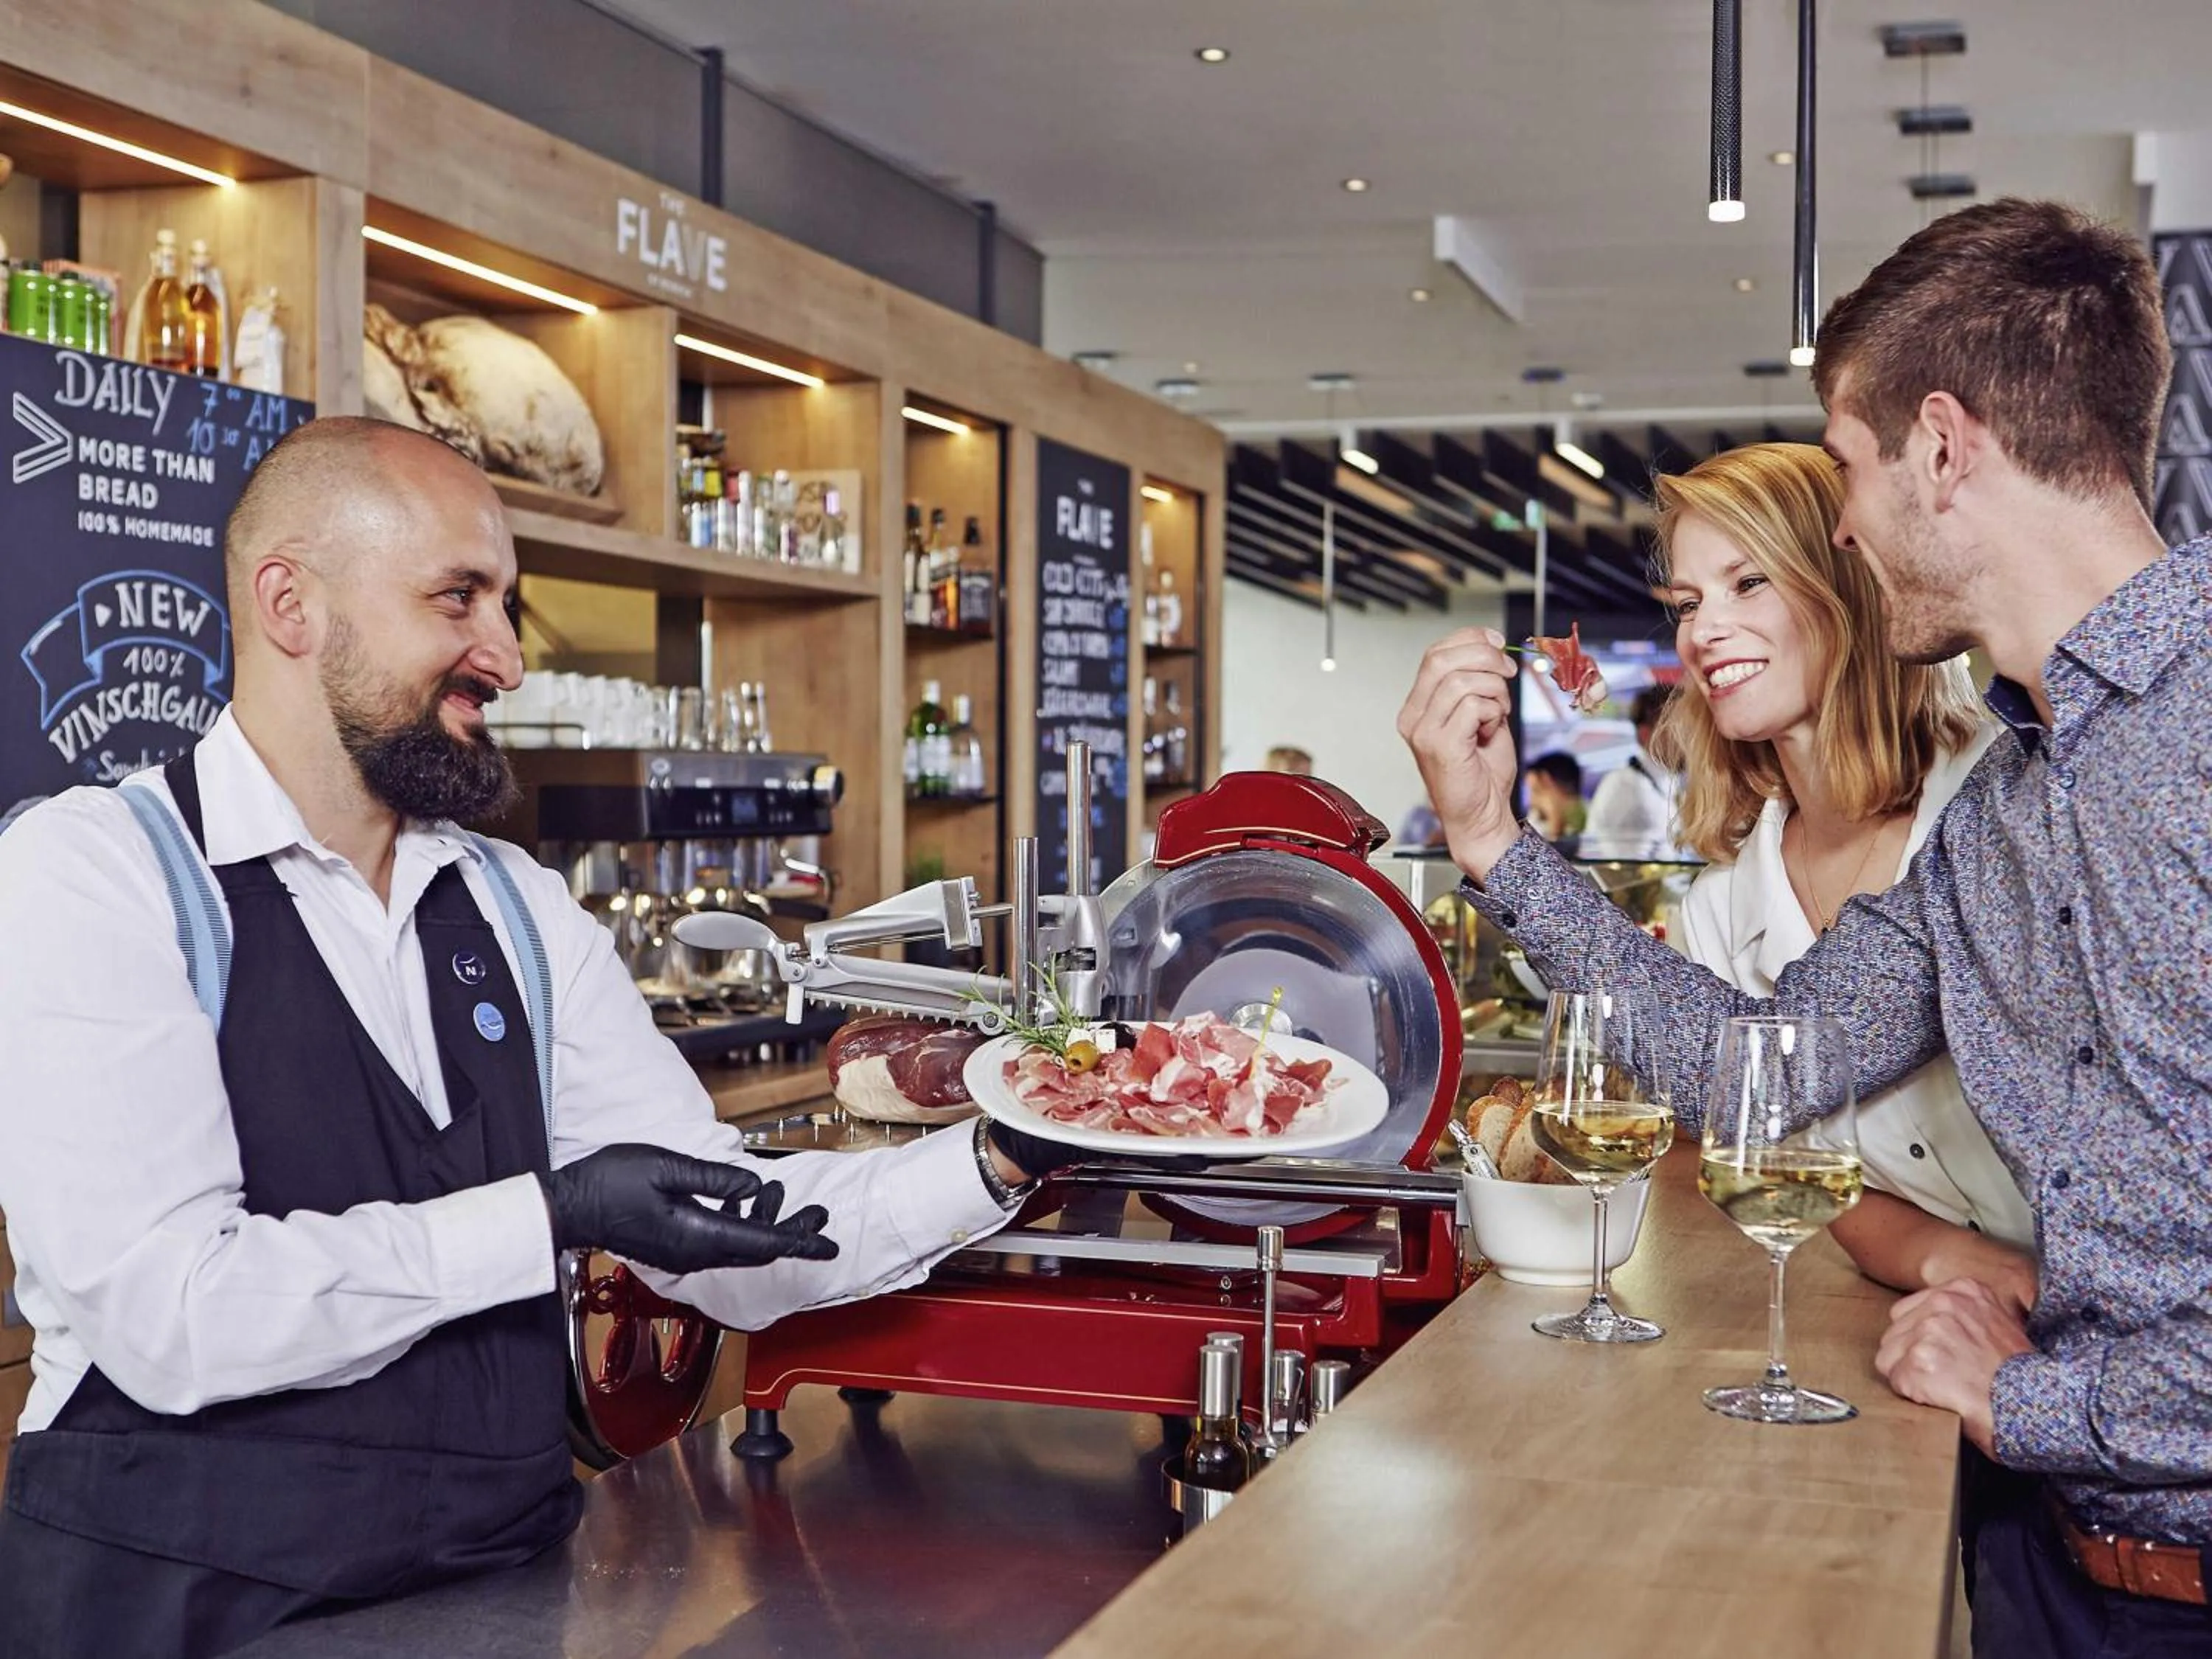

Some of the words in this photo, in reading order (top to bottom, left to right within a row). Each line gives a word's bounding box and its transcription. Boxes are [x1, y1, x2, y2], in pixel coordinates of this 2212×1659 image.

[617, 198, 728, 291] FLAVE
[55, 351, 176, 435] DAILY
[201, 382, 218, 417] 7
[245, 394, 287, 434] AM
[187, 417, 215, 454] 10
[79, 437, 146, 473] MORE
[152, 449, 215, 484] THAN
[79, 473, 159, 509] BREAD
[78, 511, 120, 535] 100%
[125, 518, 215, 547] HOMEMADE
[115, 582, 212, 637] NEW
[123, 647, 186, 678] 100%
